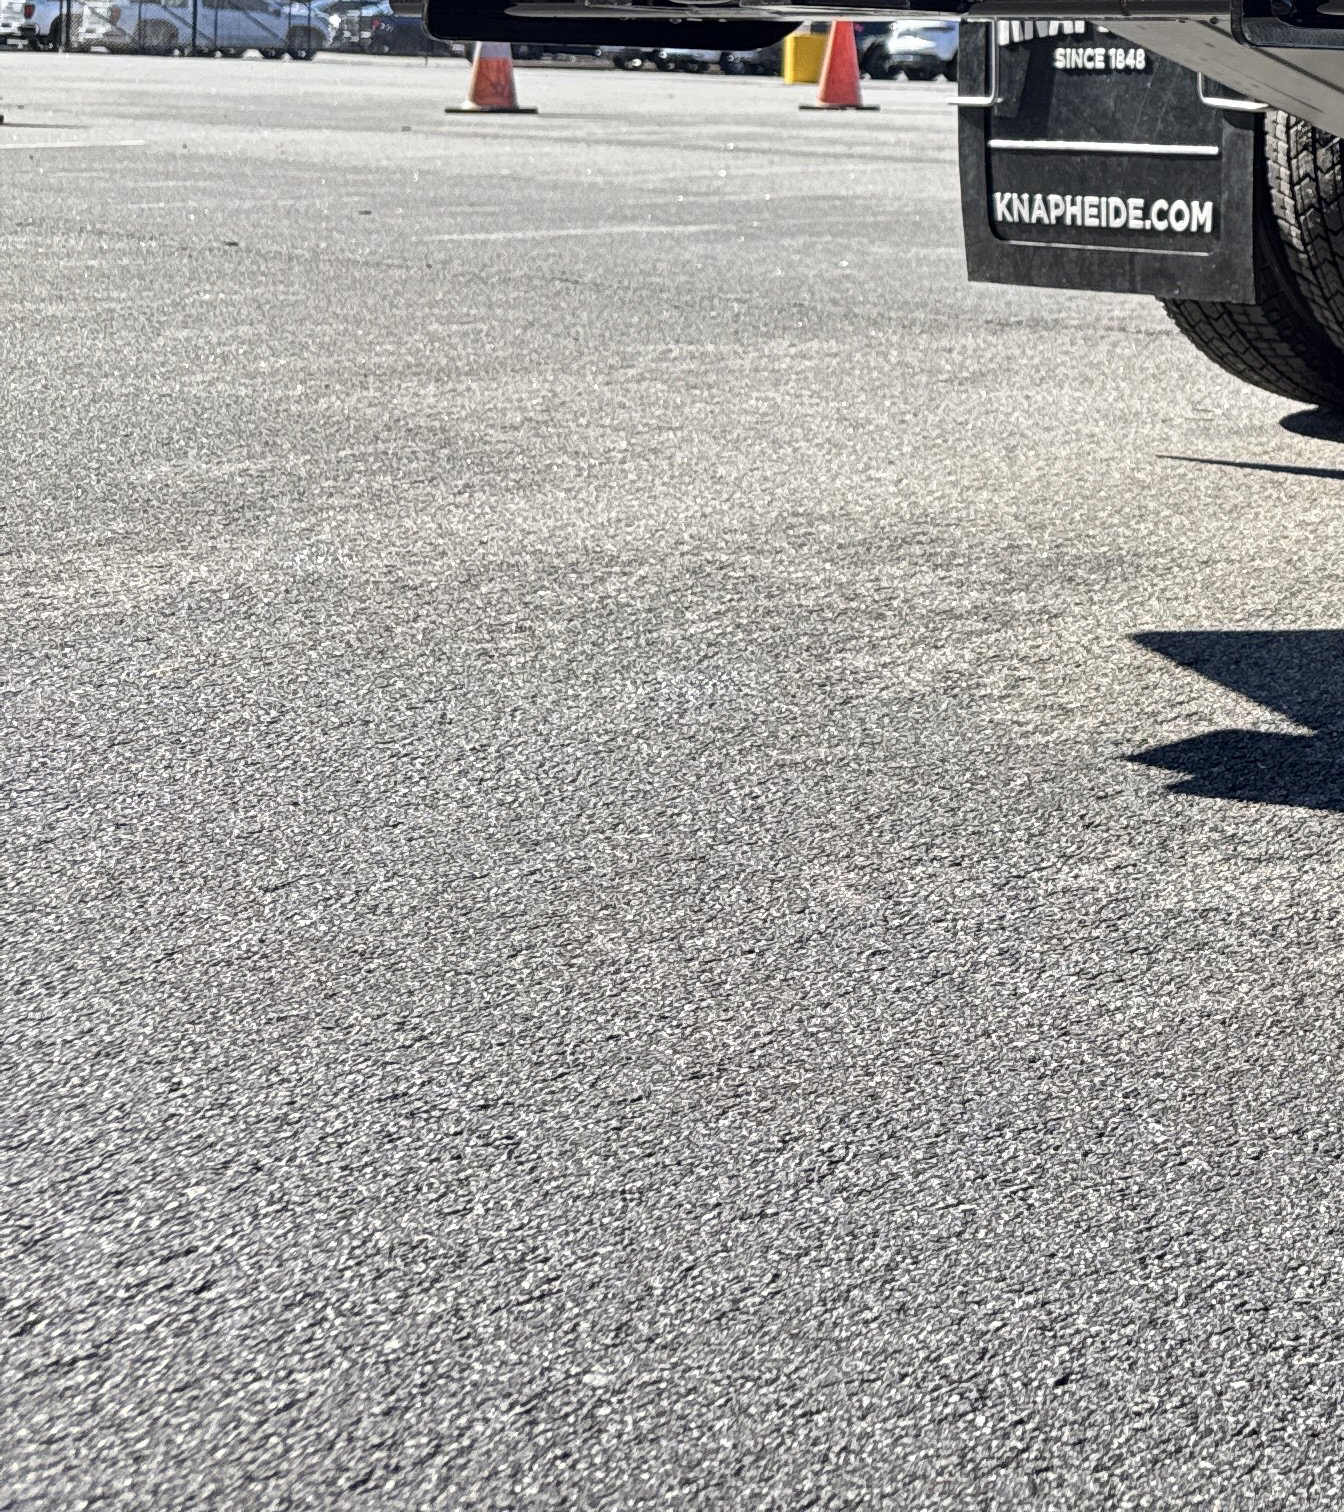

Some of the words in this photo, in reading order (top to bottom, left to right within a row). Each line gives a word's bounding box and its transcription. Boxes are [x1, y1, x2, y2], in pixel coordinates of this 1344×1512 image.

[1054, 47, 1105, 70] SINCE
[1108, 48, 1146, 70] 1848
[993, 191, 1213, 233] KNAPHEIDE.COM
